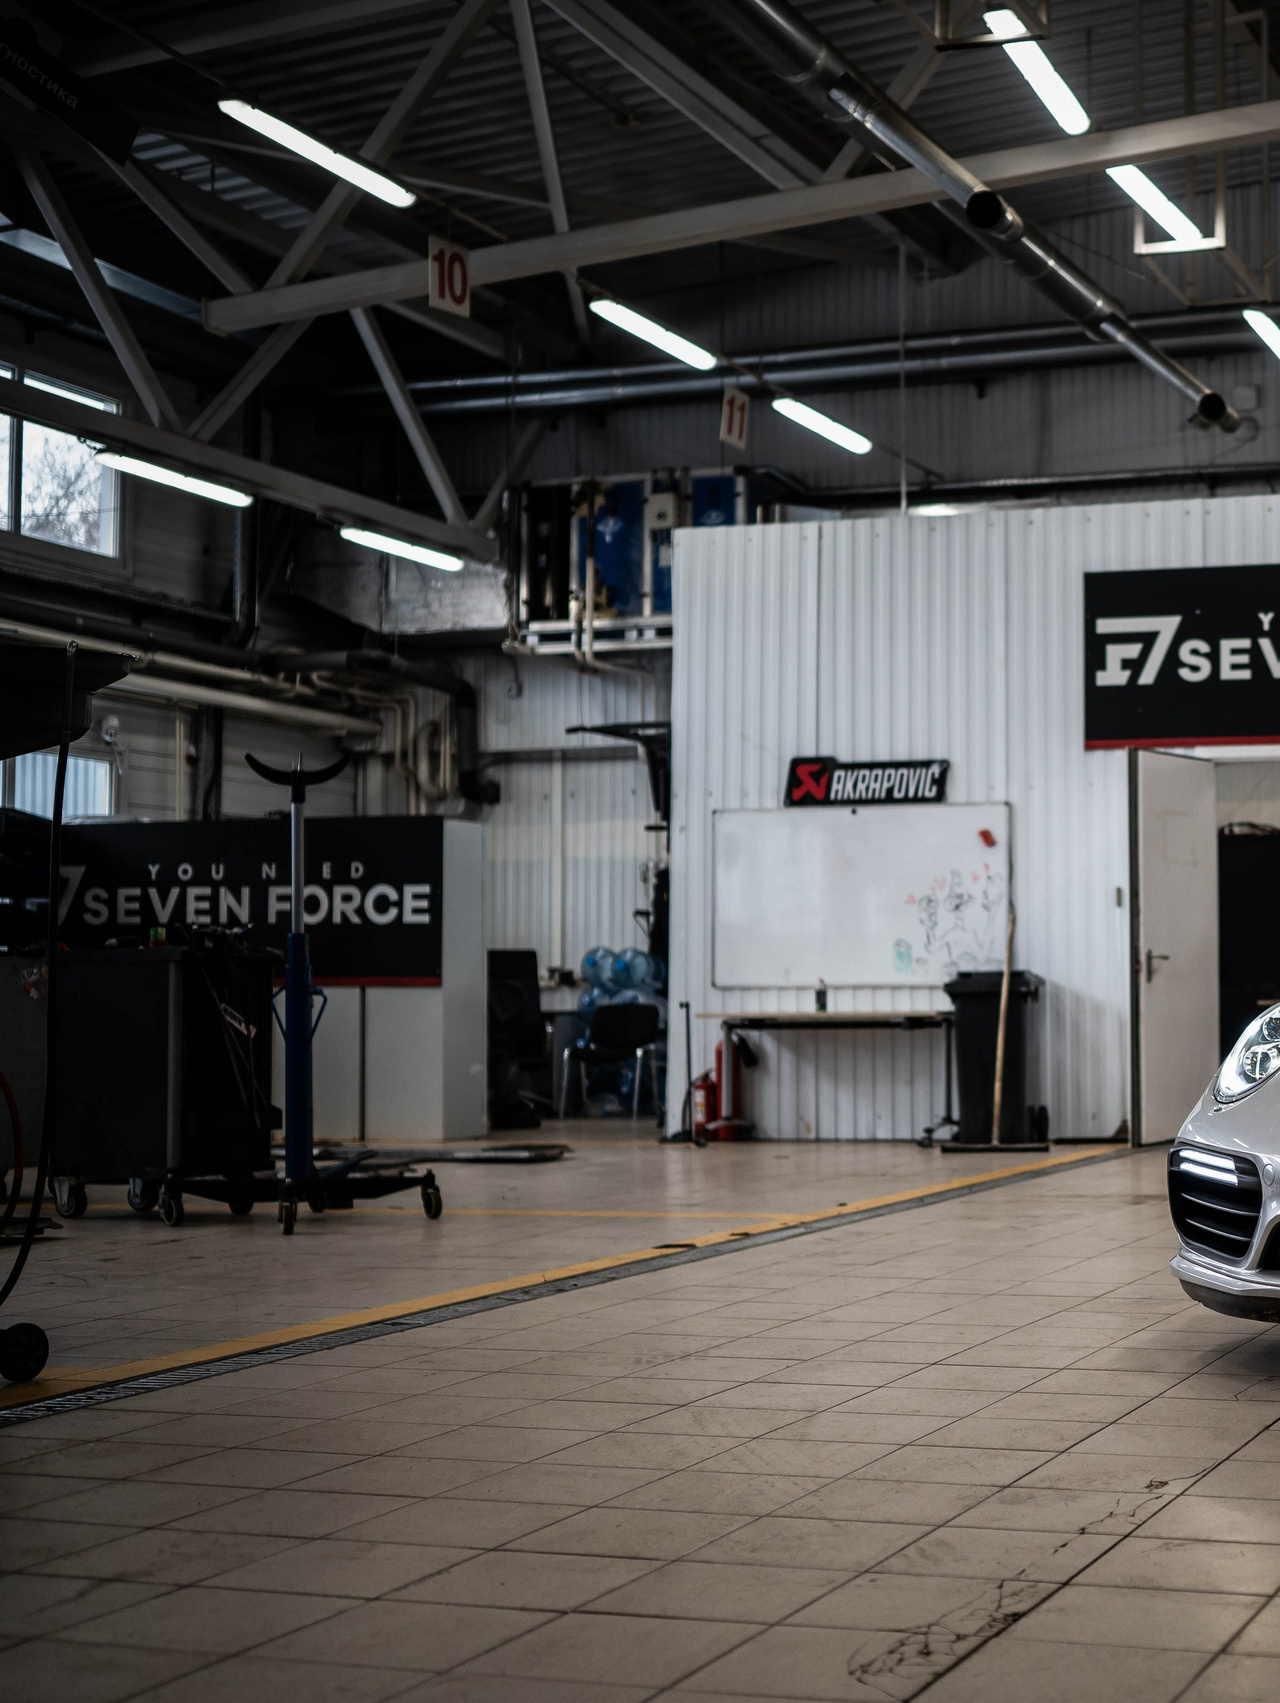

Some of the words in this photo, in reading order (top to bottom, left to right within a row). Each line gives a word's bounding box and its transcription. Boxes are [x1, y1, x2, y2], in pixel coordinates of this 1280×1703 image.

[432, 248, 467, 305] 10
[726, 396, 746, 441] 11
[147, 862, 225, 881] YOU
[262, 860, 365, 880] NED
[82, 885, 251, 926] SEVEN
[267, 883, 432, 926] FORCE
